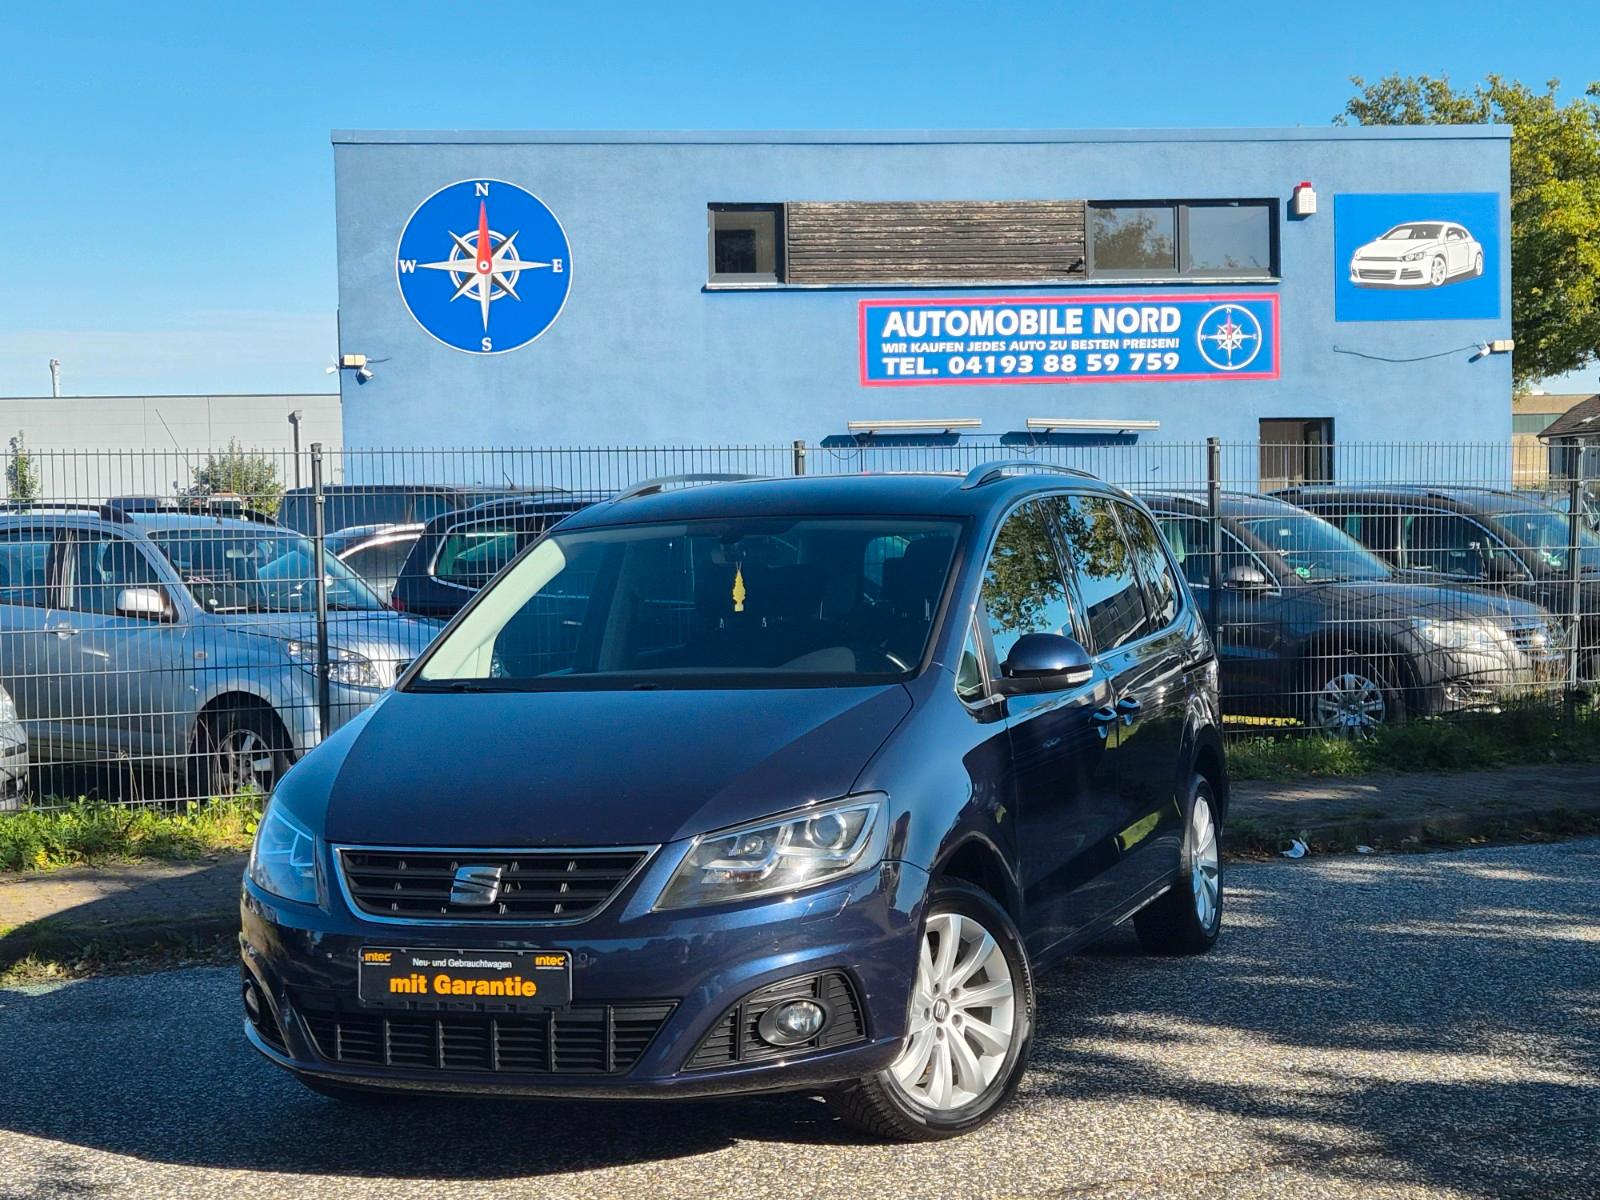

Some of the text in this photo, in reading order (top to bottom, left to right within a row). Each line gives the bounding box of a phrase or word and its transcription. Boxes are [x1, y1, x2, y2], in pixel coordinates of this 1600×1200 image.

[475, 183, 489, 197] N
[399, 259, 417, 274] W
[552, 258, 563, 273] E
[882, 307, 1181, 338] AUTOMOBILE NORD
[481, 337, 493, 352] S
[882, 337, 1180, 353] WIR KAUFEN JEDES AUTO ZU BESTEN PREISEN!
[882, 352, 1179, 375] TEL. 04193 88 59 759
[412, 957, 513, 970] Neu- und Gebrauchtwagen
[390, 973, 537, 997] mit Garantie
